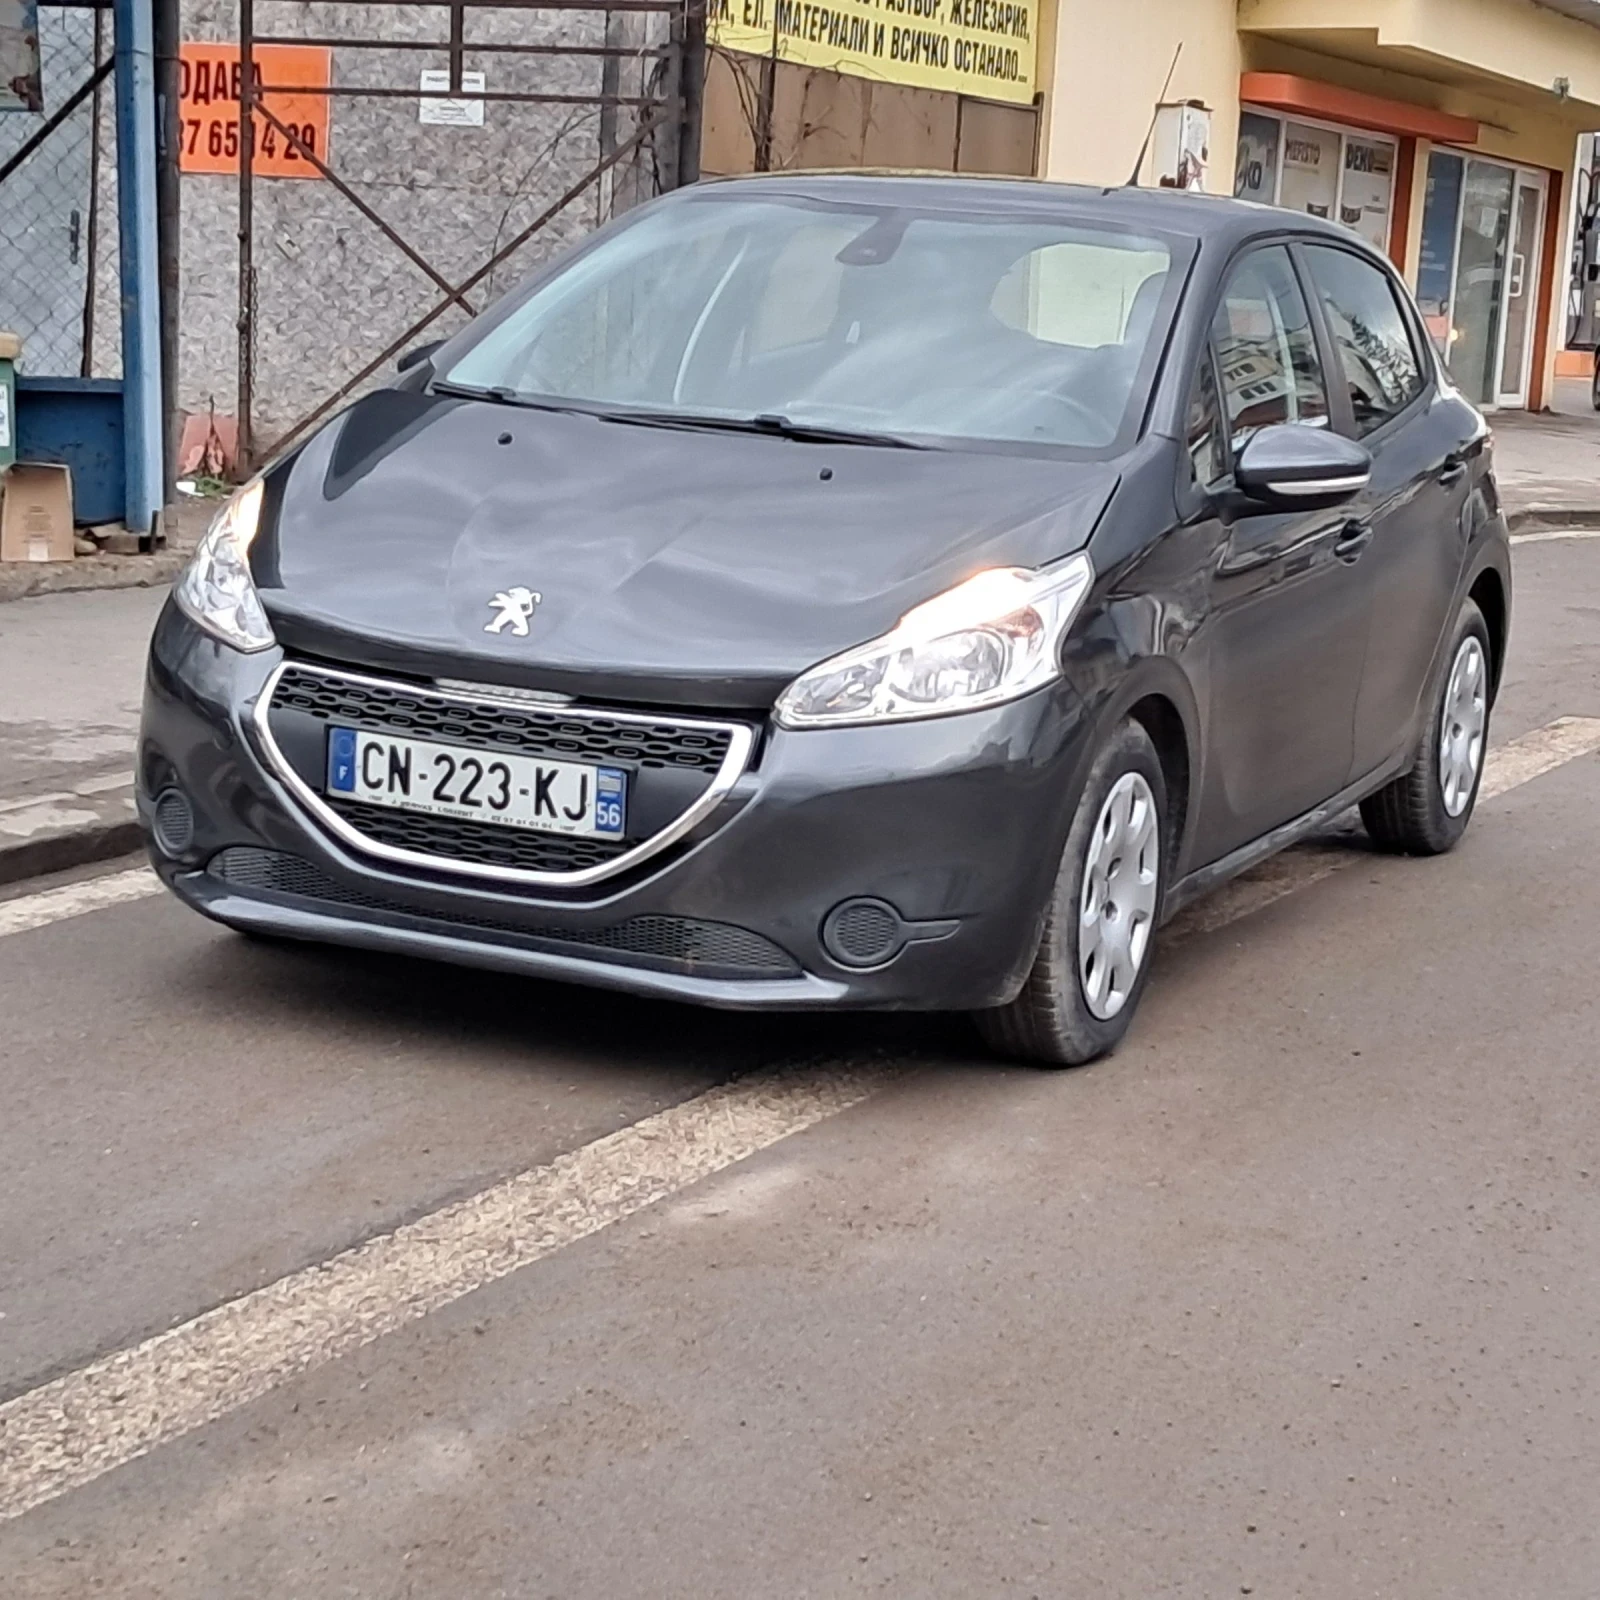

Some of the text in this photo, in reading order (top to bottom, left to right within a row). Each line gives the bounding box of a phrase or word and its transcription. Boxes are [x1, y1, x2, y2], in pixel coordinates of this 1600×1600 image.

[778, 0, 870, 55] МАТЕРИАЛИ
[873, 19, 885, 57] И
[890, 26, 949, 68] ВСИЧКО
[954, 38, 1028, 83] ОСТАНАЛО...
[949, 0, 1030, 44] ЖЕЛЕЗАРИЯ,
[208, 120, 239, 158] 65
[339, 766, 348, 781] F
[361, 741, 588, 821] CN-223-KJ
[596, 803, 621, 827] 56
